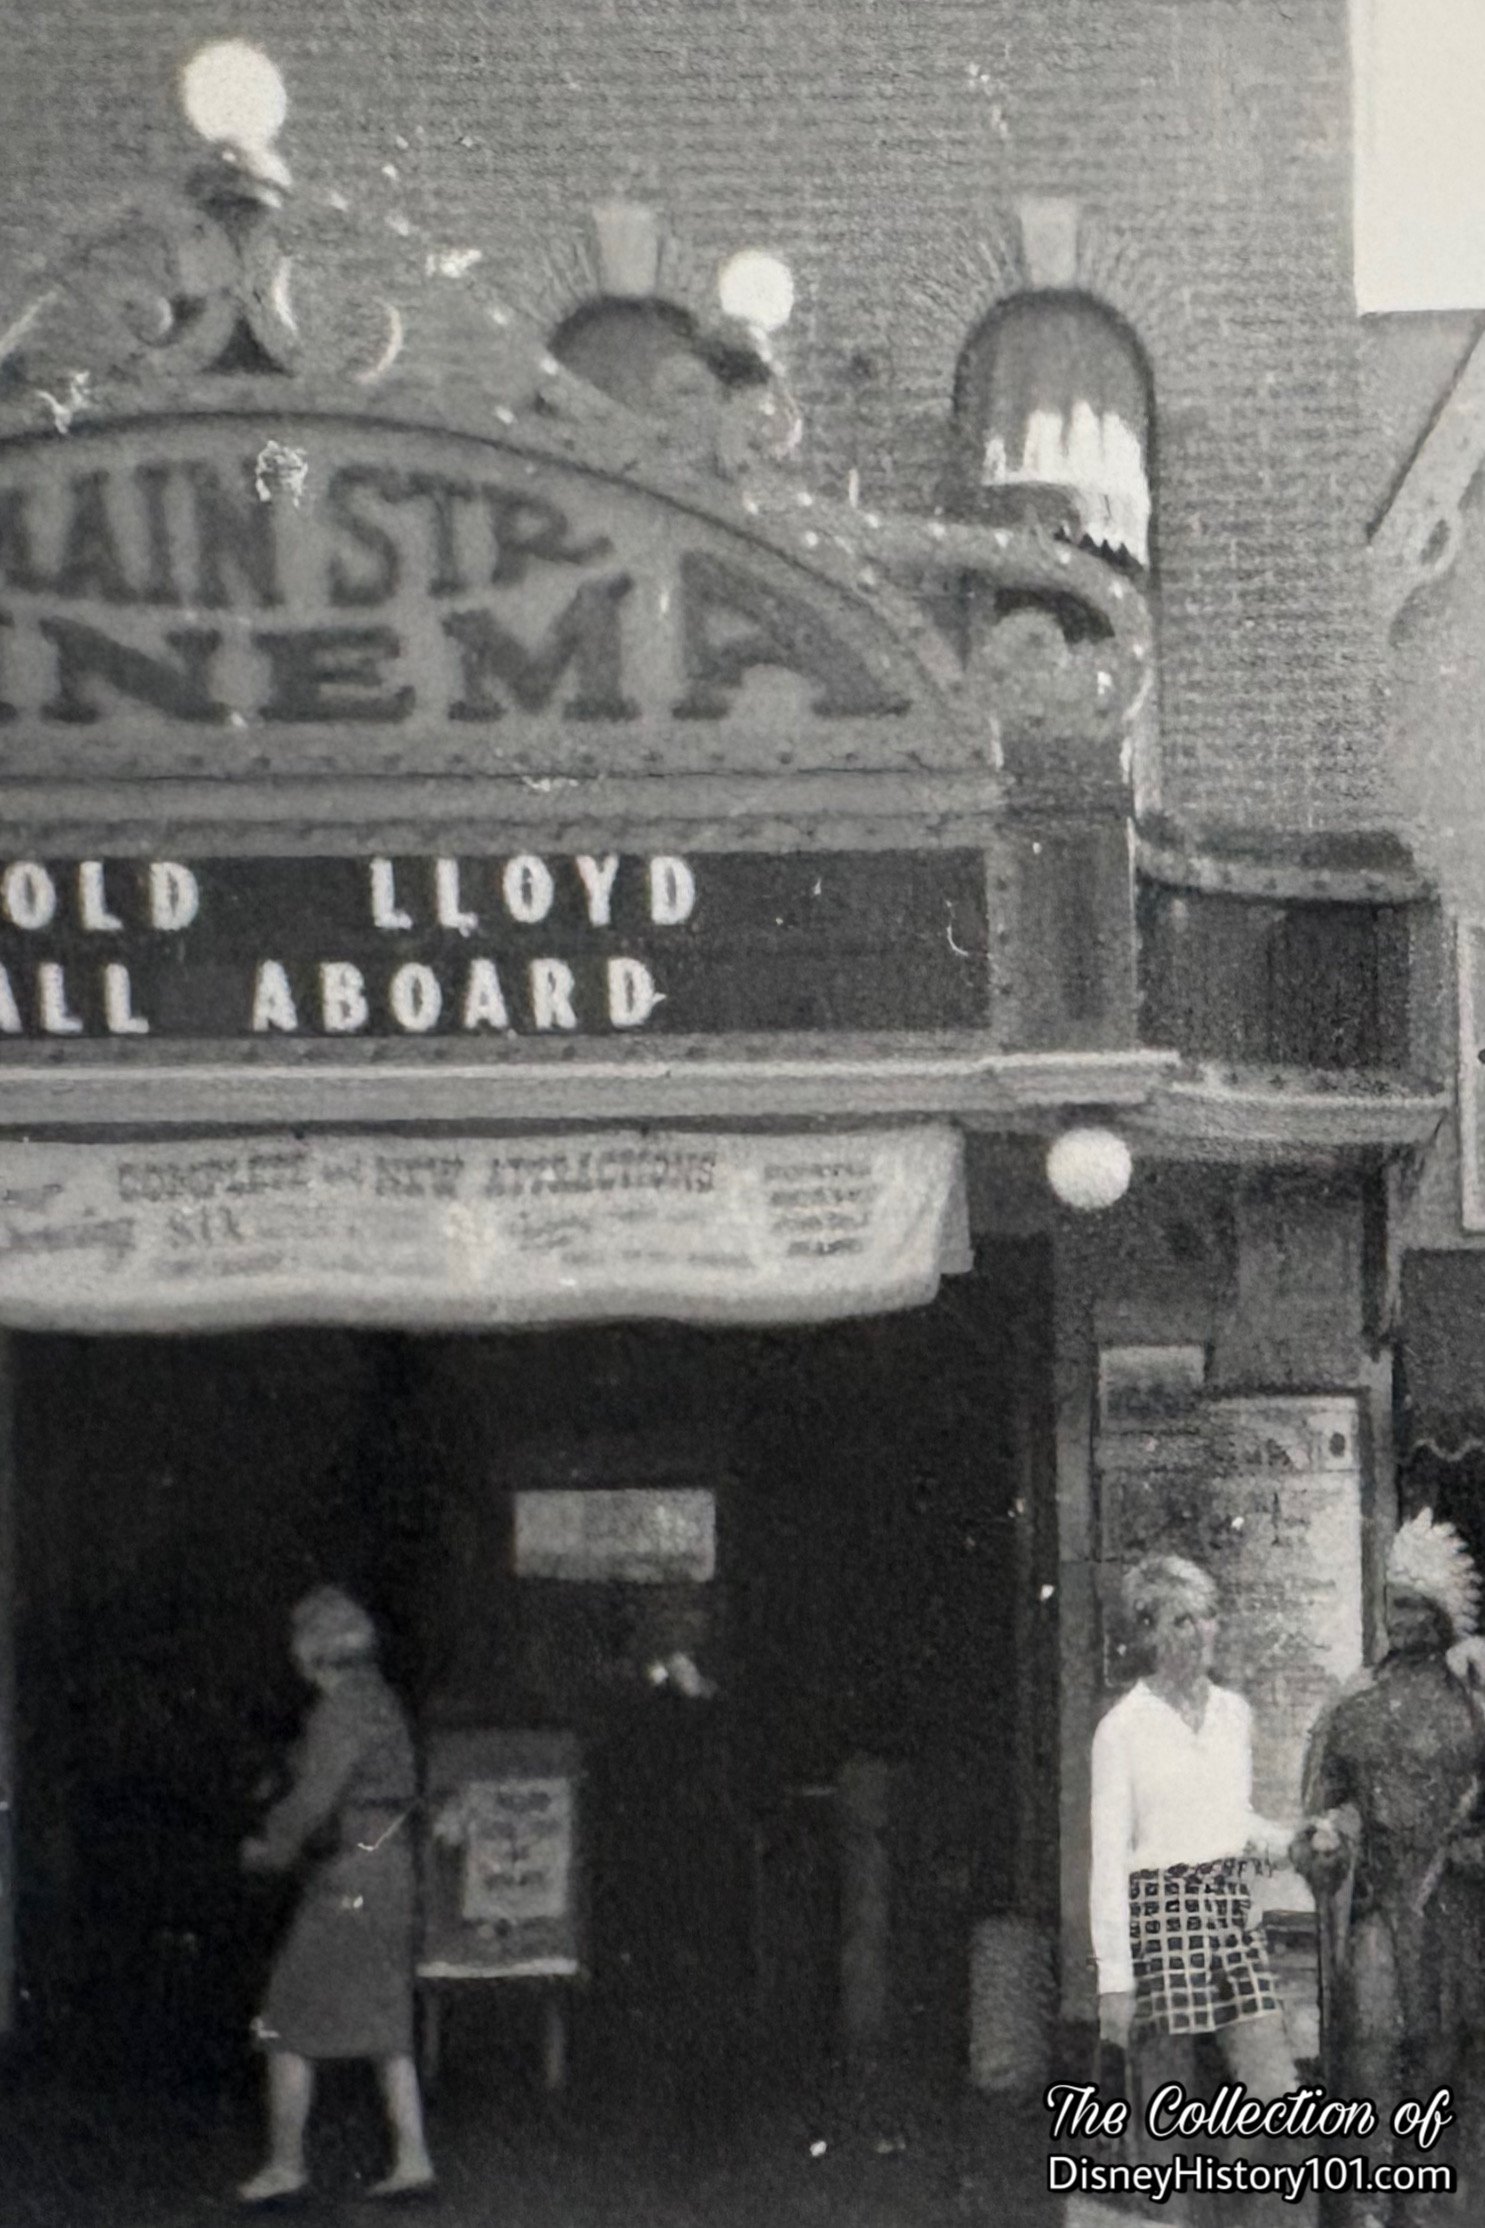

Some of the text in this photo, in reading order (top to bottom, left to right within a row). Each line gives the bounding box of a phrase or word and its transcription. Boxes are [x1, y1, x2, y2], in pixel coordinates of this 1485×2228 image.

[0, 552, 912, 722] NEMA
[370, 855, 696, 935] LLOYD
[251, 957, 658, 1032] ABOARD
